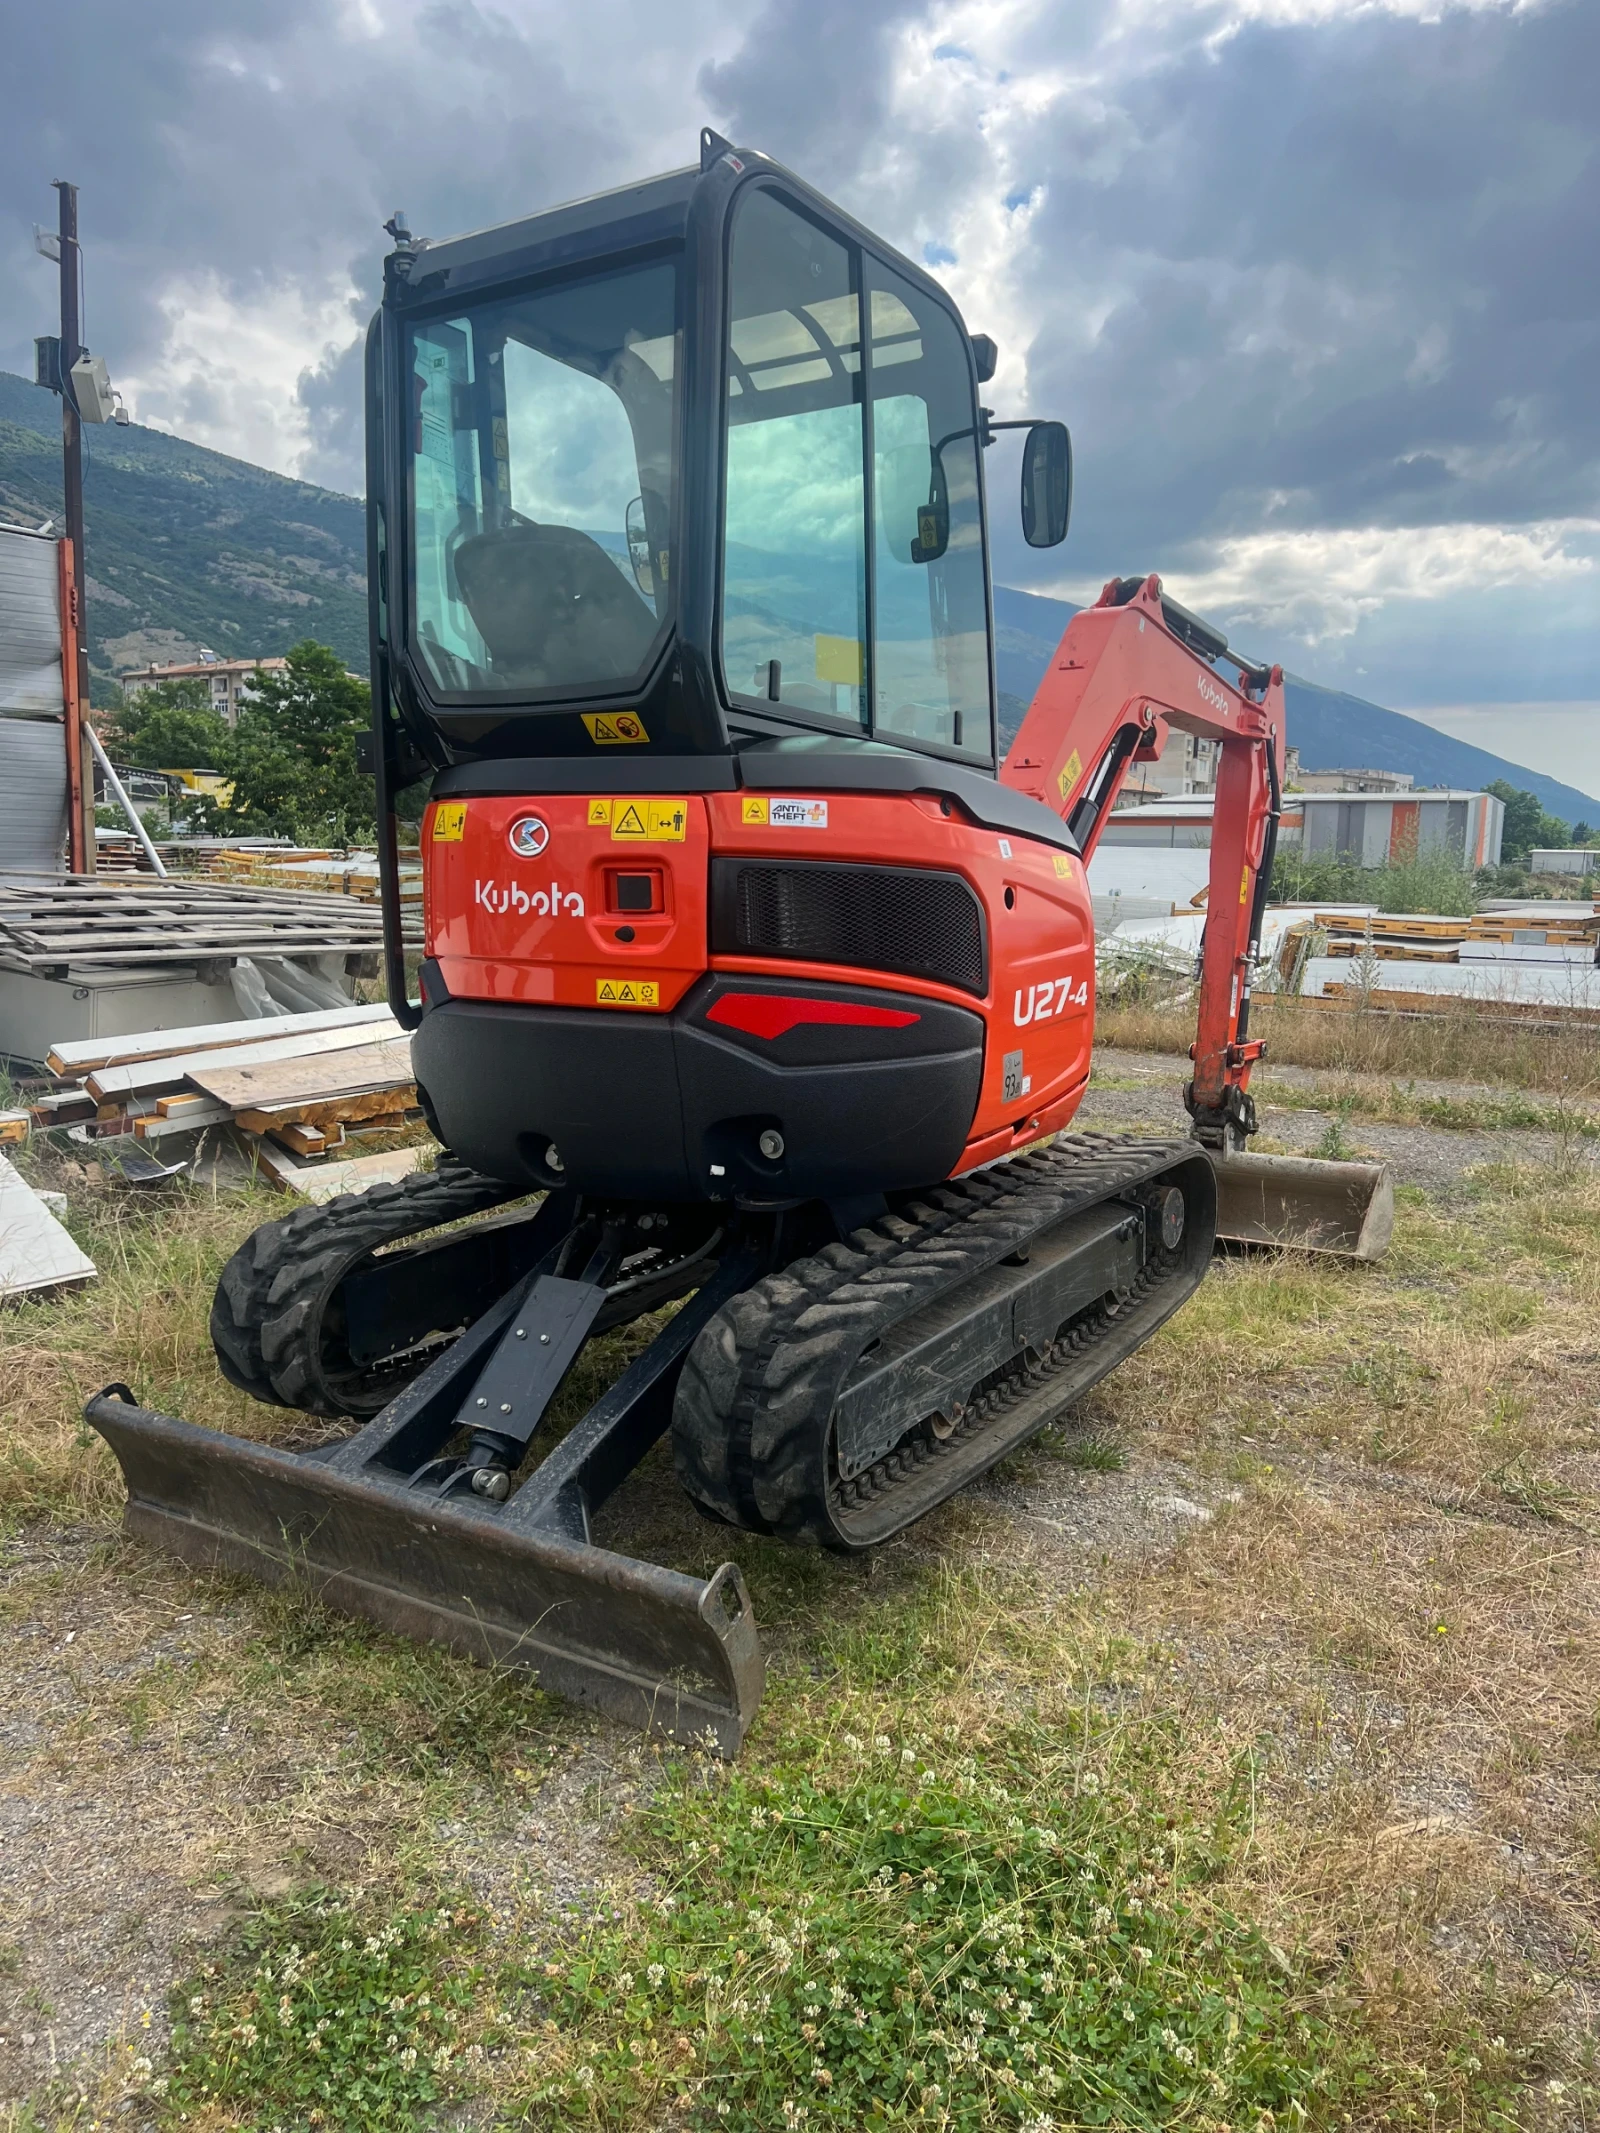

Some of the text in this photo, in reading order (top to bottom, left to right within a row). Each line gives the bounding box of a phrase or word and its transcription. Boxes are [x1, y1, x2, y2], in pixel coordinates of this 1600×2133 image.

[1198, 674, 1228, 716] Kubota
[772, 812, 806, 820] THEFT
[475, 879, 584, 917] Kubota
[1013, 975, 1088, 1027] U27-4
[1004, 1073, 1015, 1098] 93
